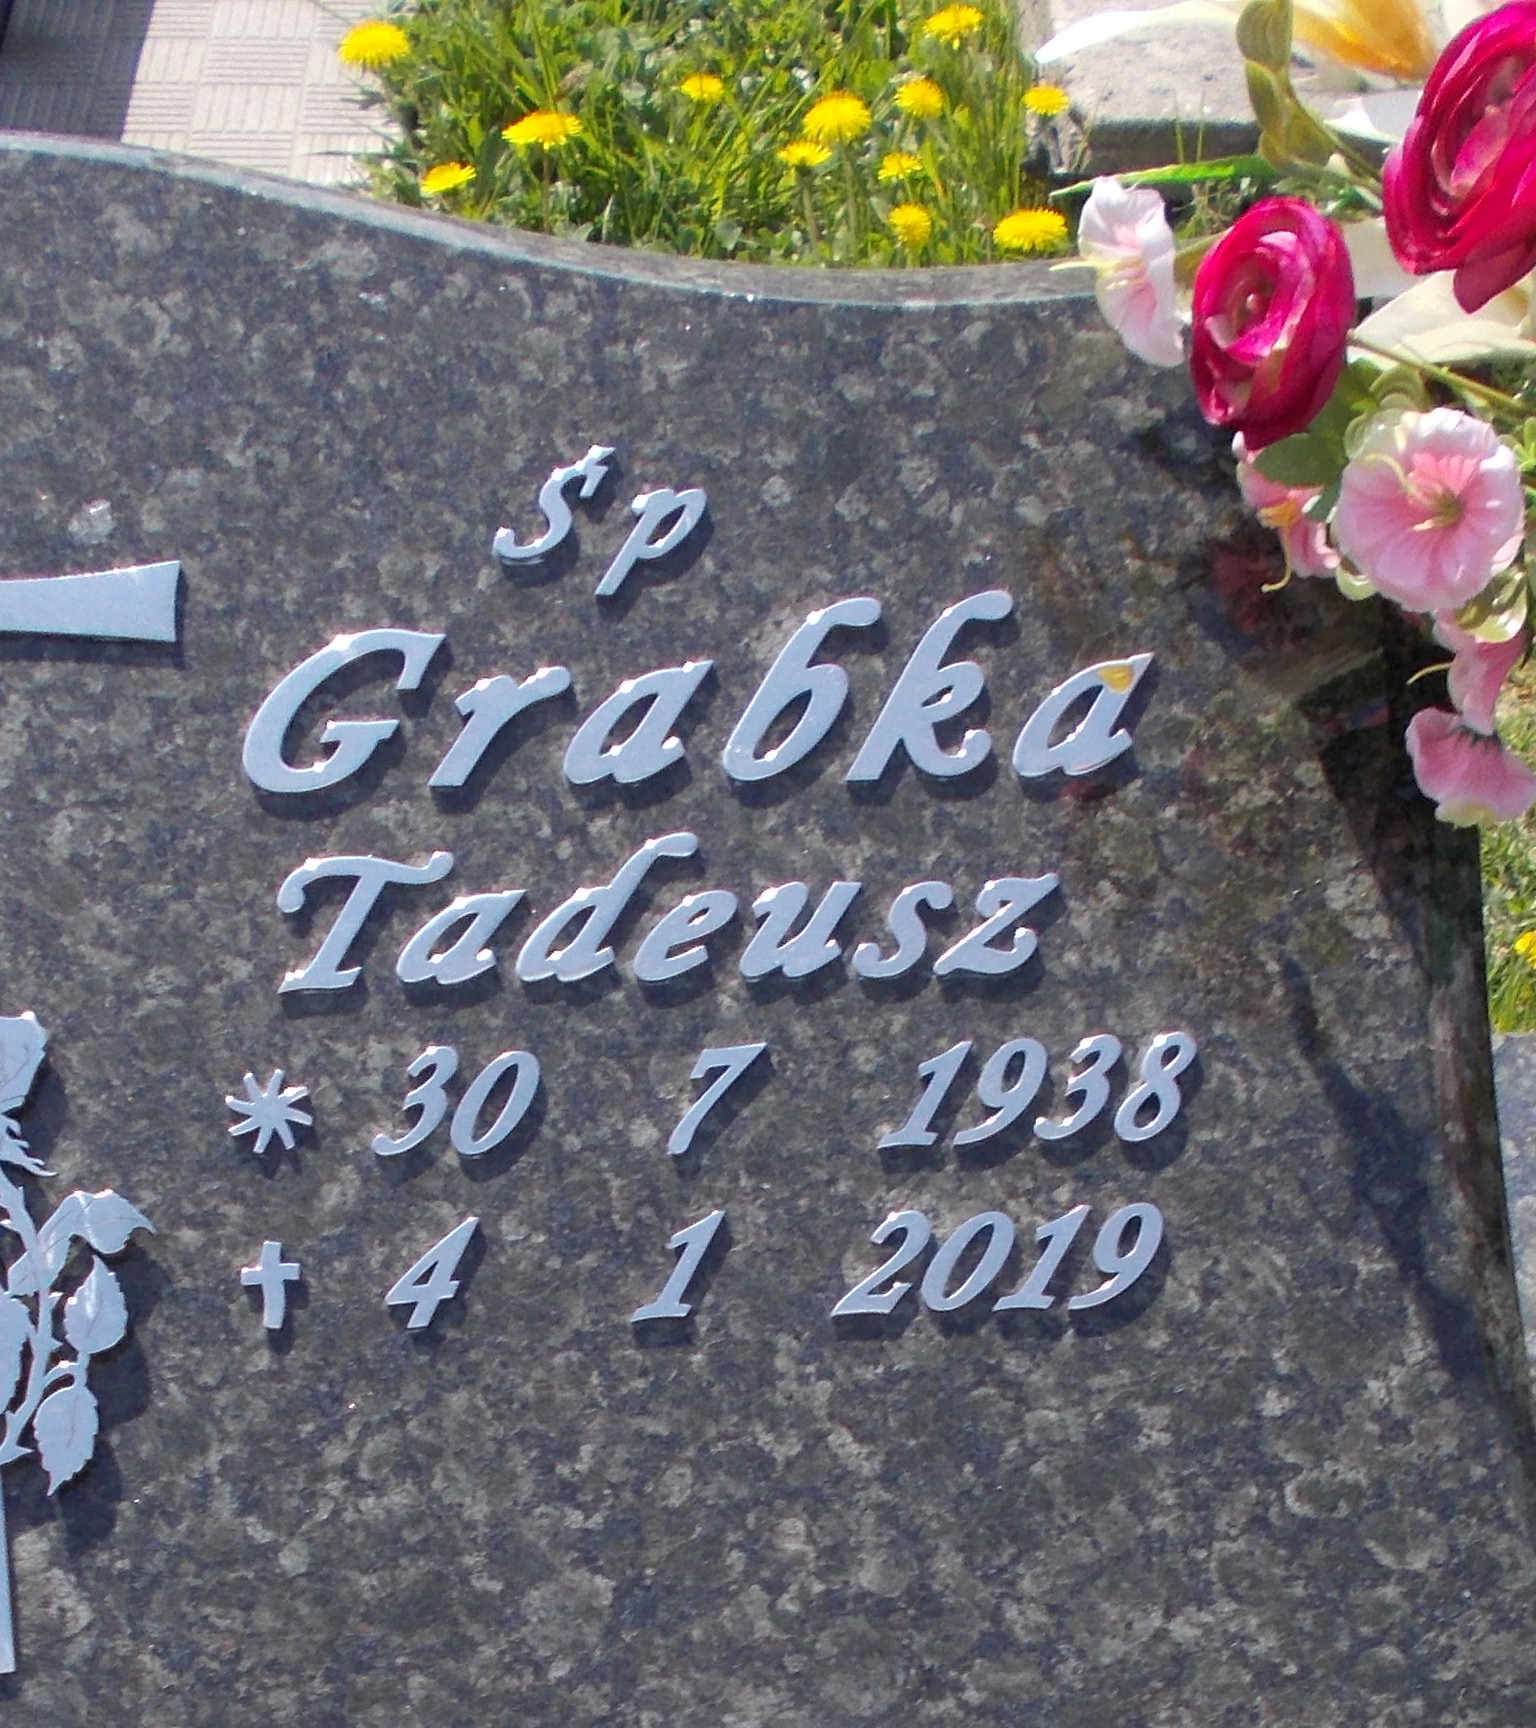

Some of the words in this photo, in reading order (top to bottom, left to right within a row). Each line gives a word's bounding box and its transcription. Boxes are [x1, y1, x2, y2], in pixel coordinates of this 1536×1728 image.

[241, 590, 1155, 793] Grabka
[276, 831, 1059, 994] Tadeusz
[371, 1045, 541, 1155] 30
[666, 1041, 768, 1155] 7
[878, 1030, 1196, 1149] 1938
[384, 1215, 479, 1330] 4
[630, 1209, 726, 1324] 1
[831, 1202, 1165, 1318] 2019
